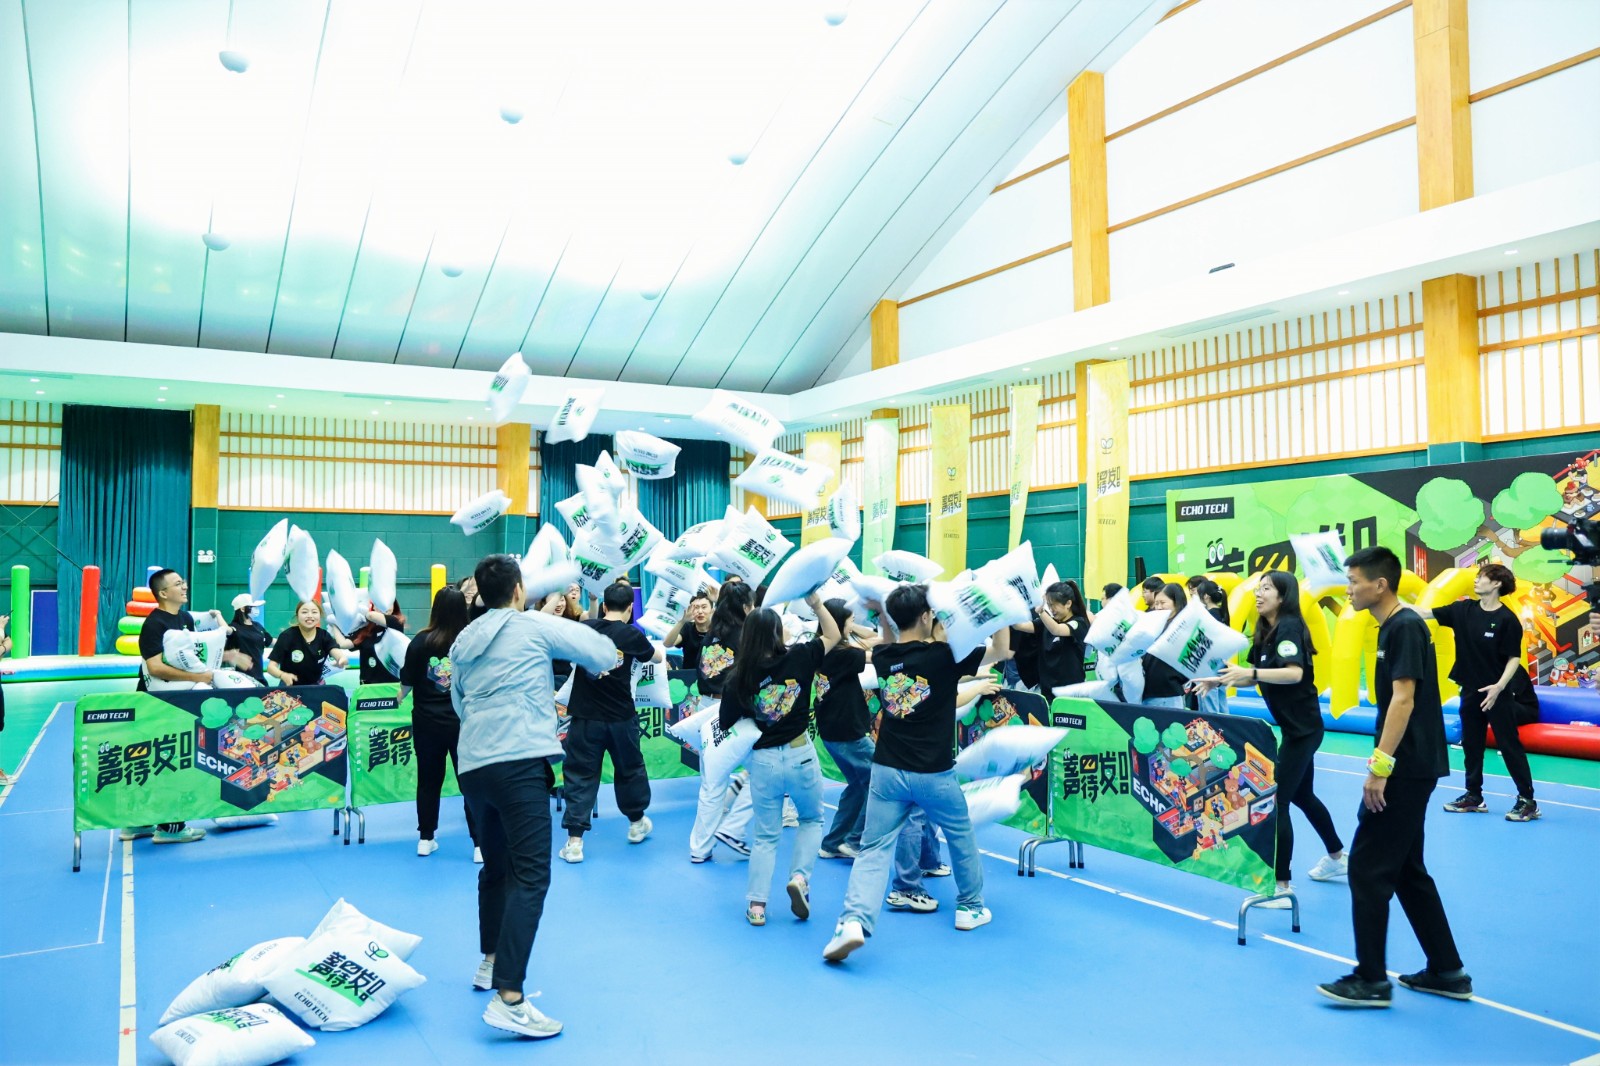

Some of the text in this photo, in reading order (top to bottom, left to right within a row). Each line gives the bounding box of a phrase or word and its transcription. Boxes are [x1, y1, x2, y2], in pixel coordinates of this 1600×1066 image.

[1181, 503, 1228, 516] ECHO TECH
[109, 711, 129, 719] TECH
[1055, 716, 1083, 726] ECHO TECH
[294, 991, 314, 1008] ECHO
[311, 1005, 330, 1023] TECH
